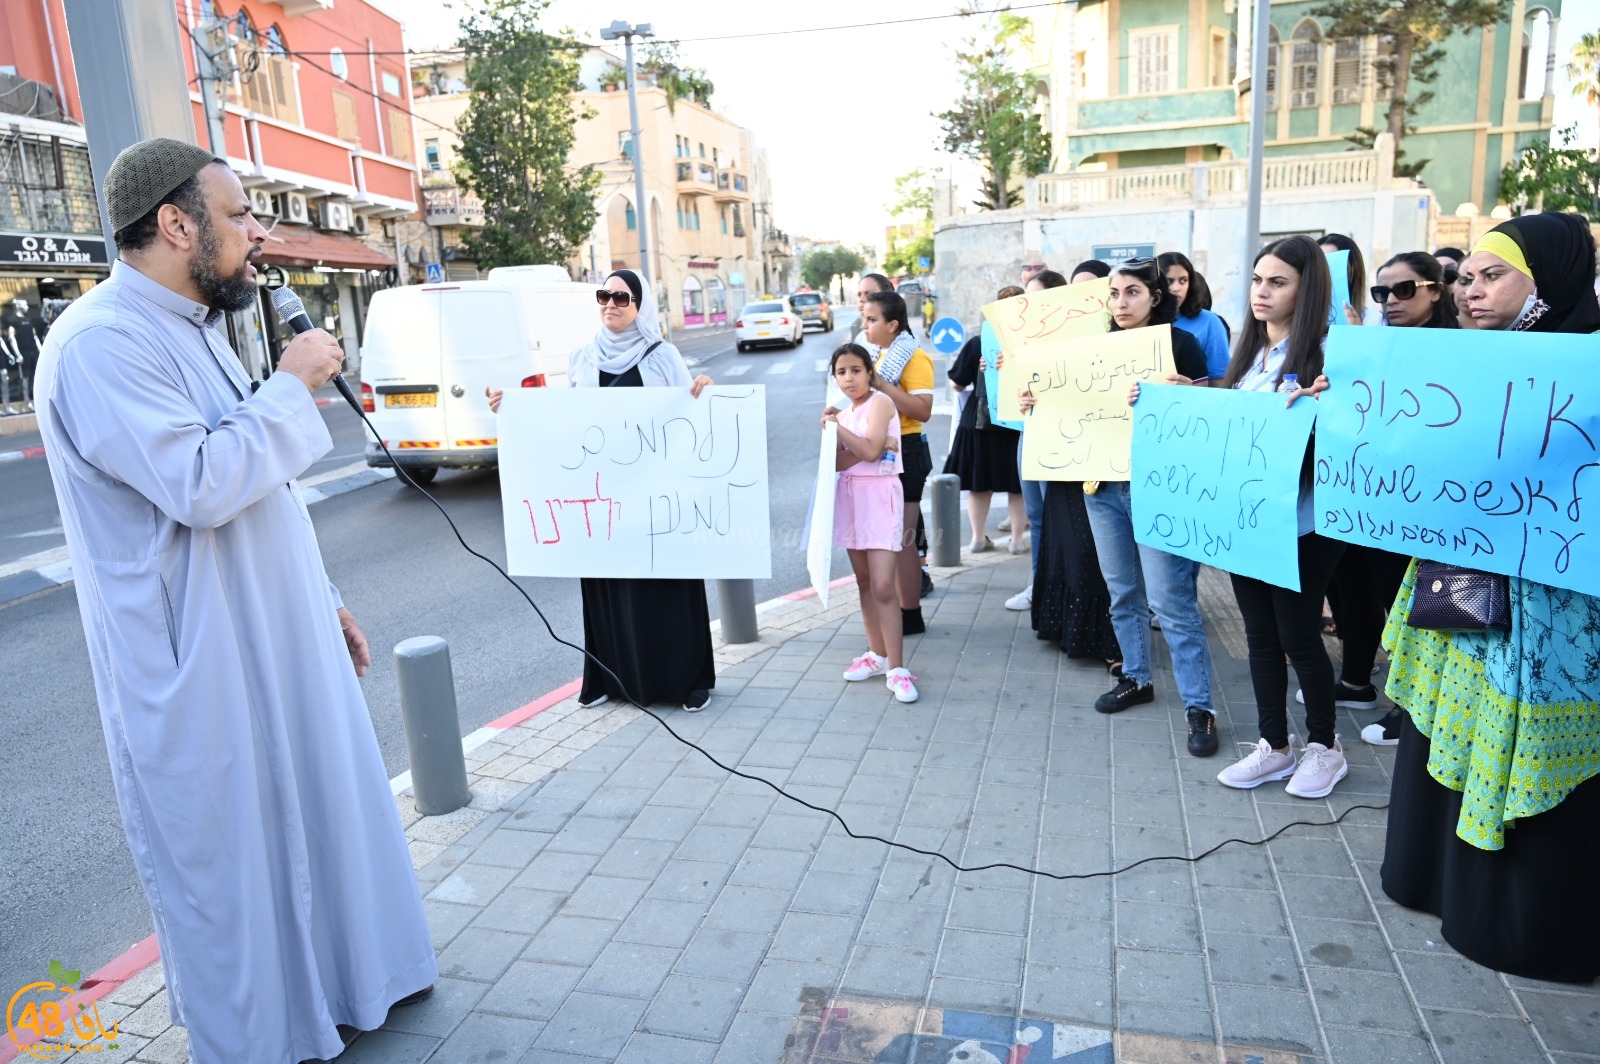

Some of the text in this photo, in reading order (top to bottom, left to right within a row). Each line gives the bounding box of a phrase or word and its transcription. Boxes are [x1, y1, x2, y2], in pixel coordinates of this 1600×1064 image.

[13, 250, 91, 263] אופנה לגבר
[22, 237, 80, 252] O & A
[1139, 401, 1267, 477] אין חמלה
[1497, 377, 1597, 460] אין
[1237, 478, 1267, 530] על
[1433, 462, 1600, 523] לאנשים
[1145, 513, 1232, 558] מגונים
[1517, 522, 1586, 577] עין
